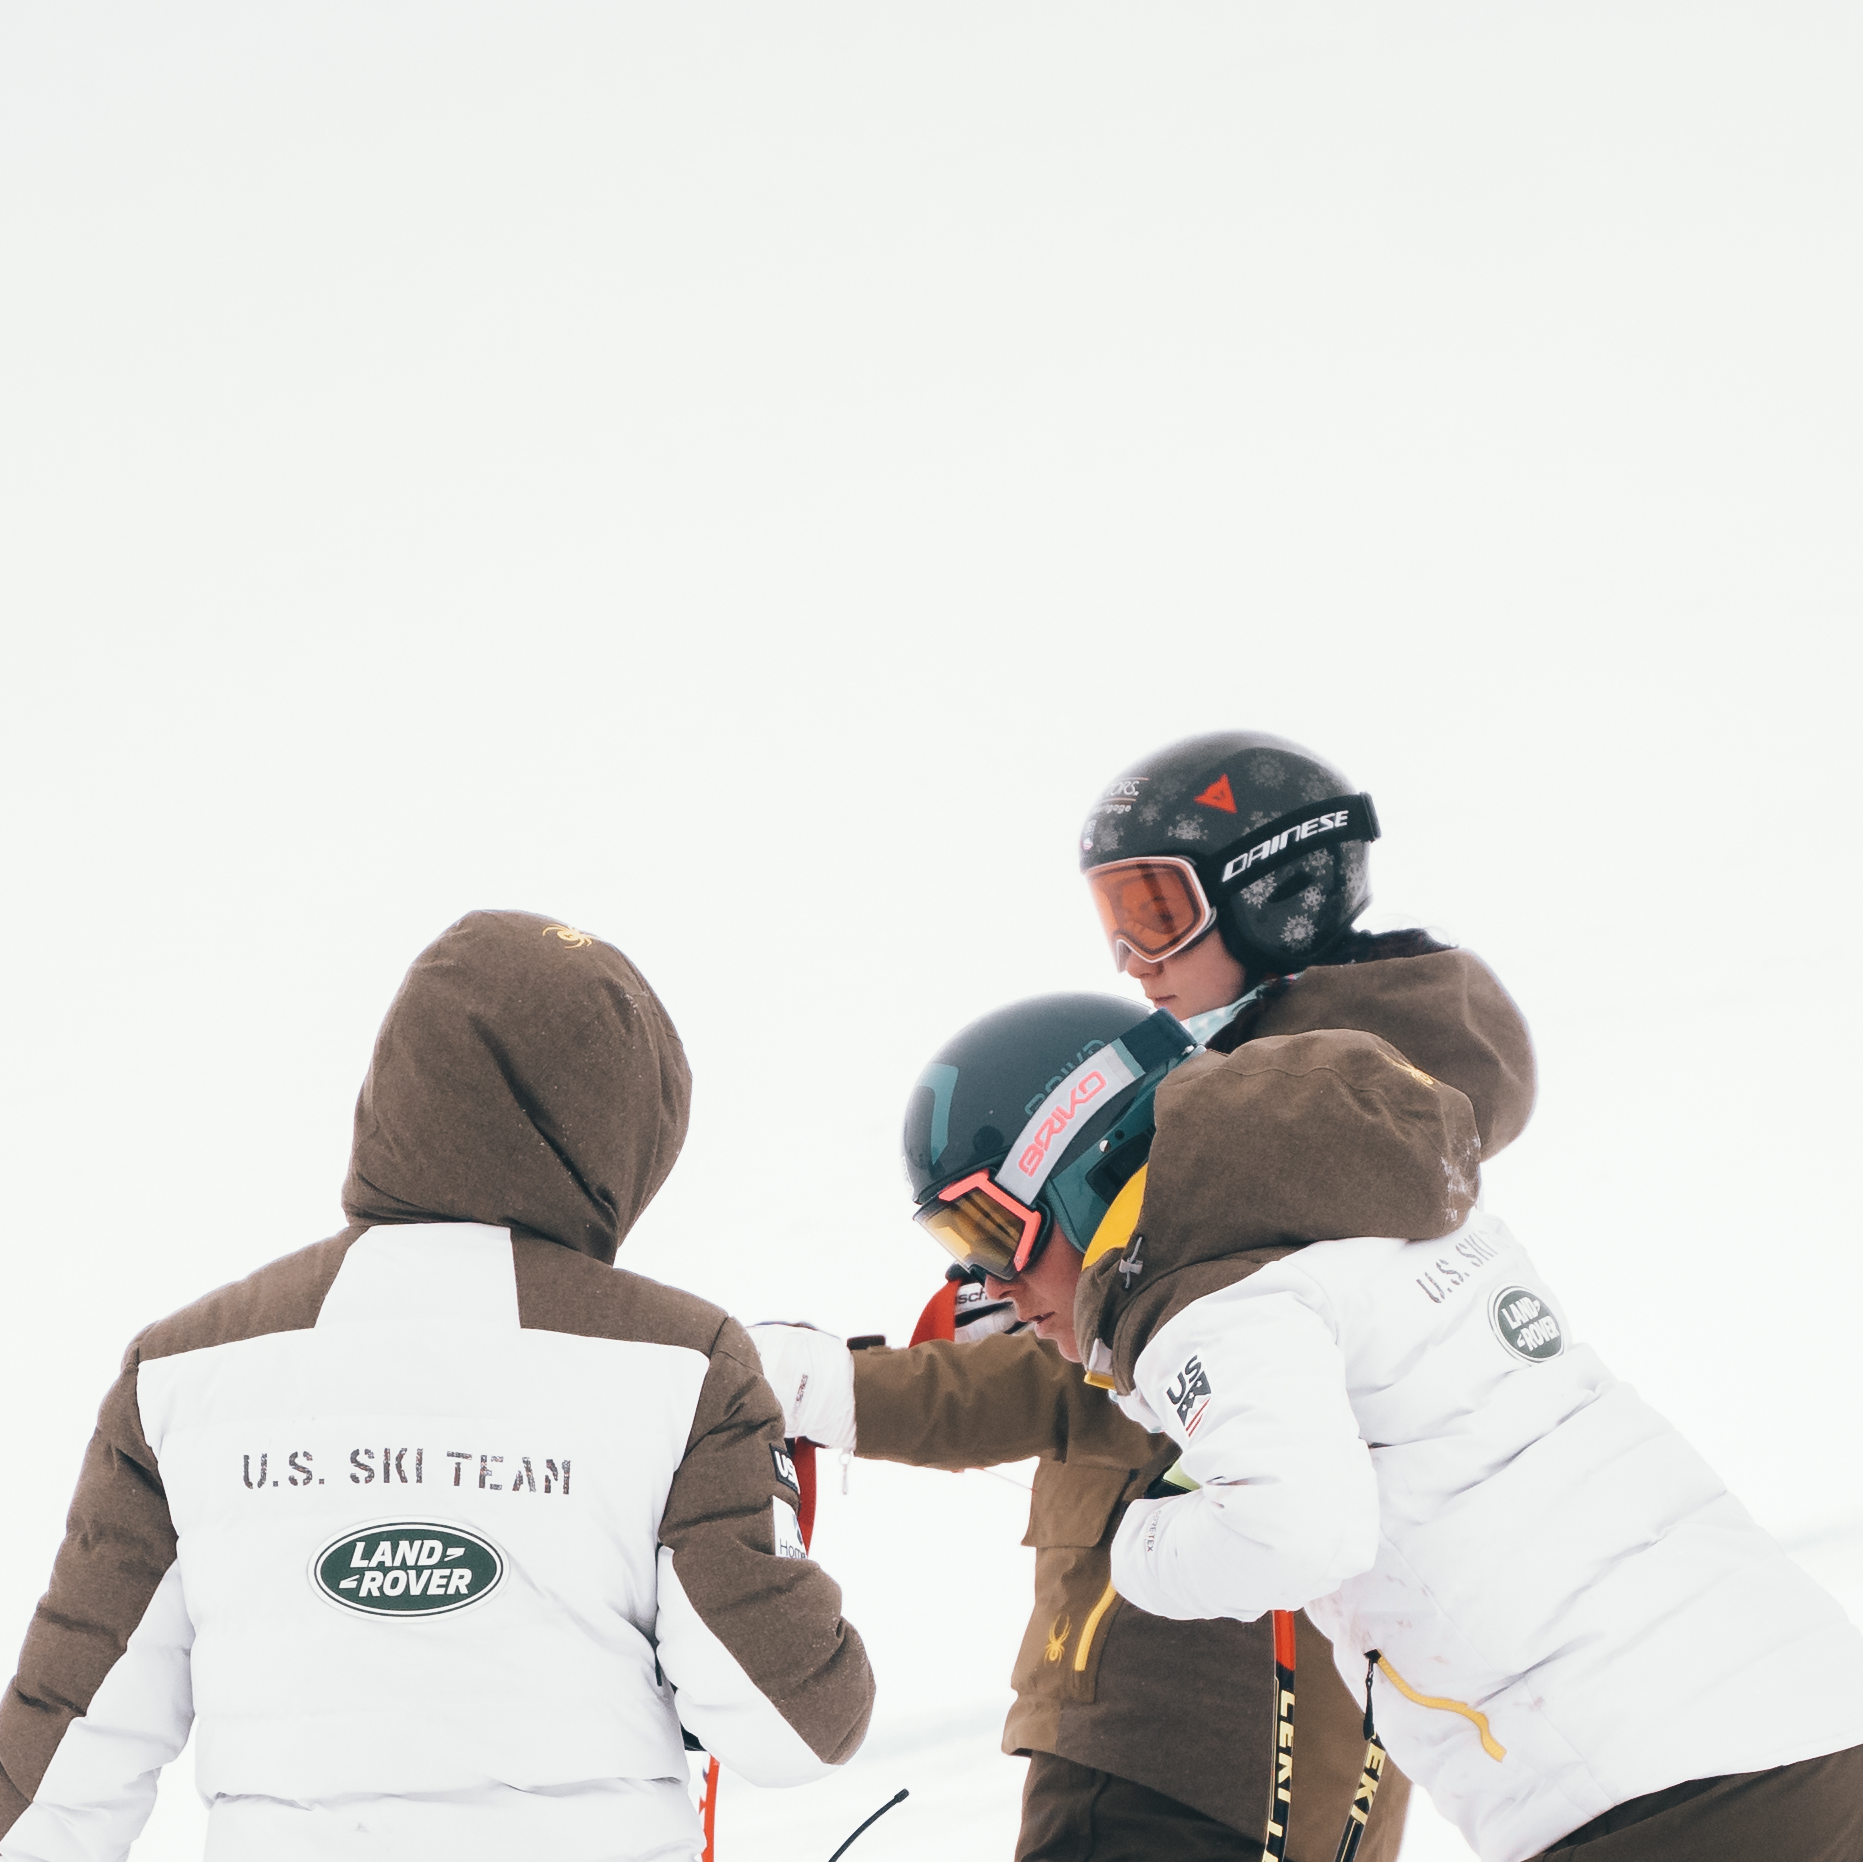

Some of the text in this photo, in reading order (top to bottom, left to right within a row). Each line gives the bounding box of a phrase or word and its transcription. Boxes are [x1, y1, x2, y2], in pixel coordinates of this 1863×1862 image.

[1222, 810, 1349, 882] DAINESE
[1416, 1259, 1470, 1303] U.S.
[1501, 1296, 1538, 1330] LAND
[1520, 1315, 1560, 1351] ROVER
[1167, 1355, 1202, 1406] US
[242, 1447, 572, 1495] U.S. SKI TEAM
[350, 1540, 442, 1569] LAND
[358, 1568, 473, 1597] ROVER
[1276, 1690, 1296, 1803] LEKI
[1351, 1733, 1387, 1826] EKI
